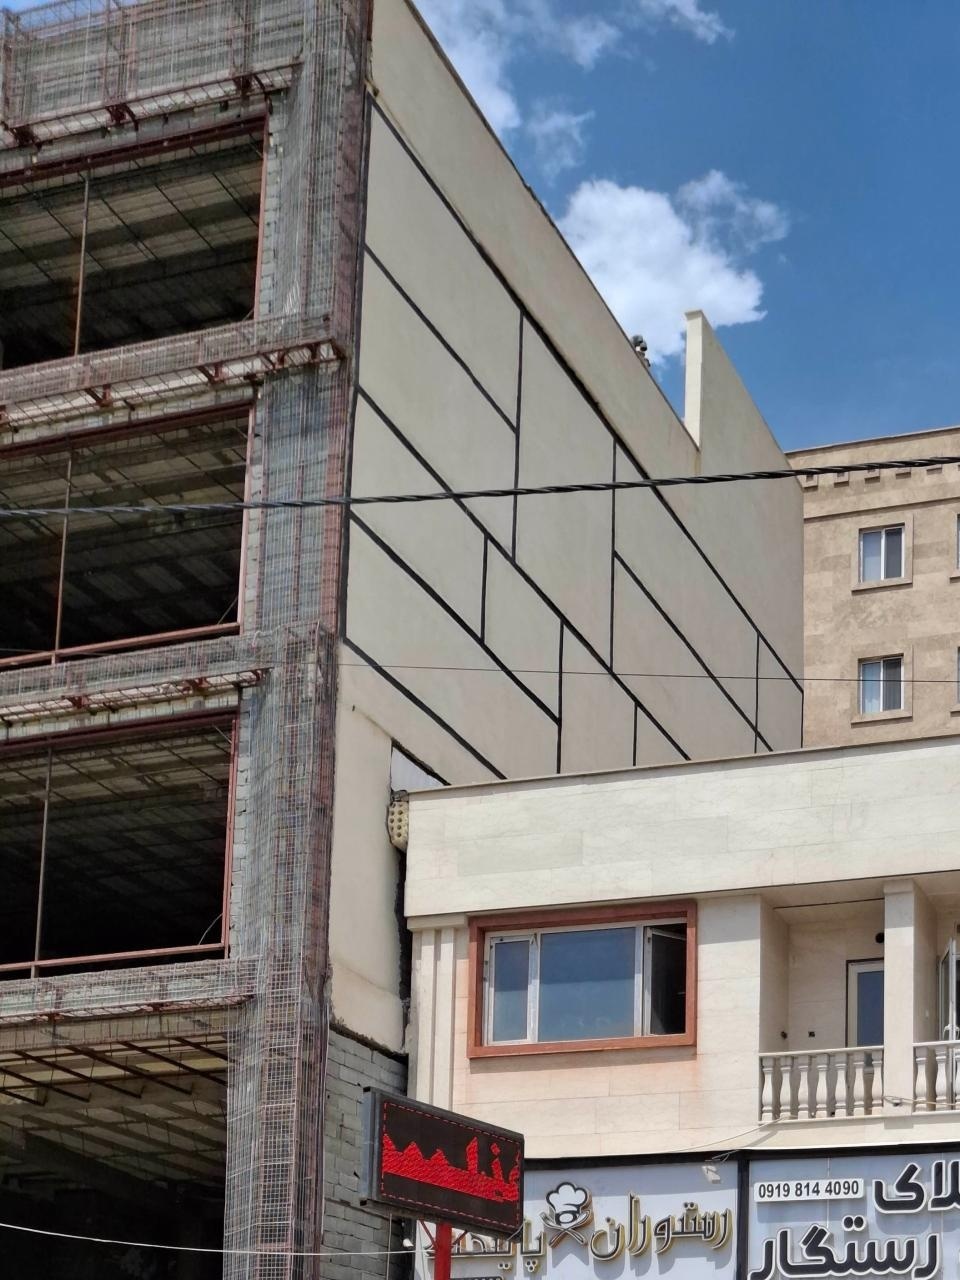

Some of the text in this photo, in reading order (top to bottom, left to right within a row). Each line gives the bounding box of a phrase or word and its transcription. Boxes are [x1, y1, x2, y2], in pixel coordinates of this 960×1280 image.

[758, 1180, 859, 1199] 0919 814 4090
[590, 1192, 732, 1260] رستوران
